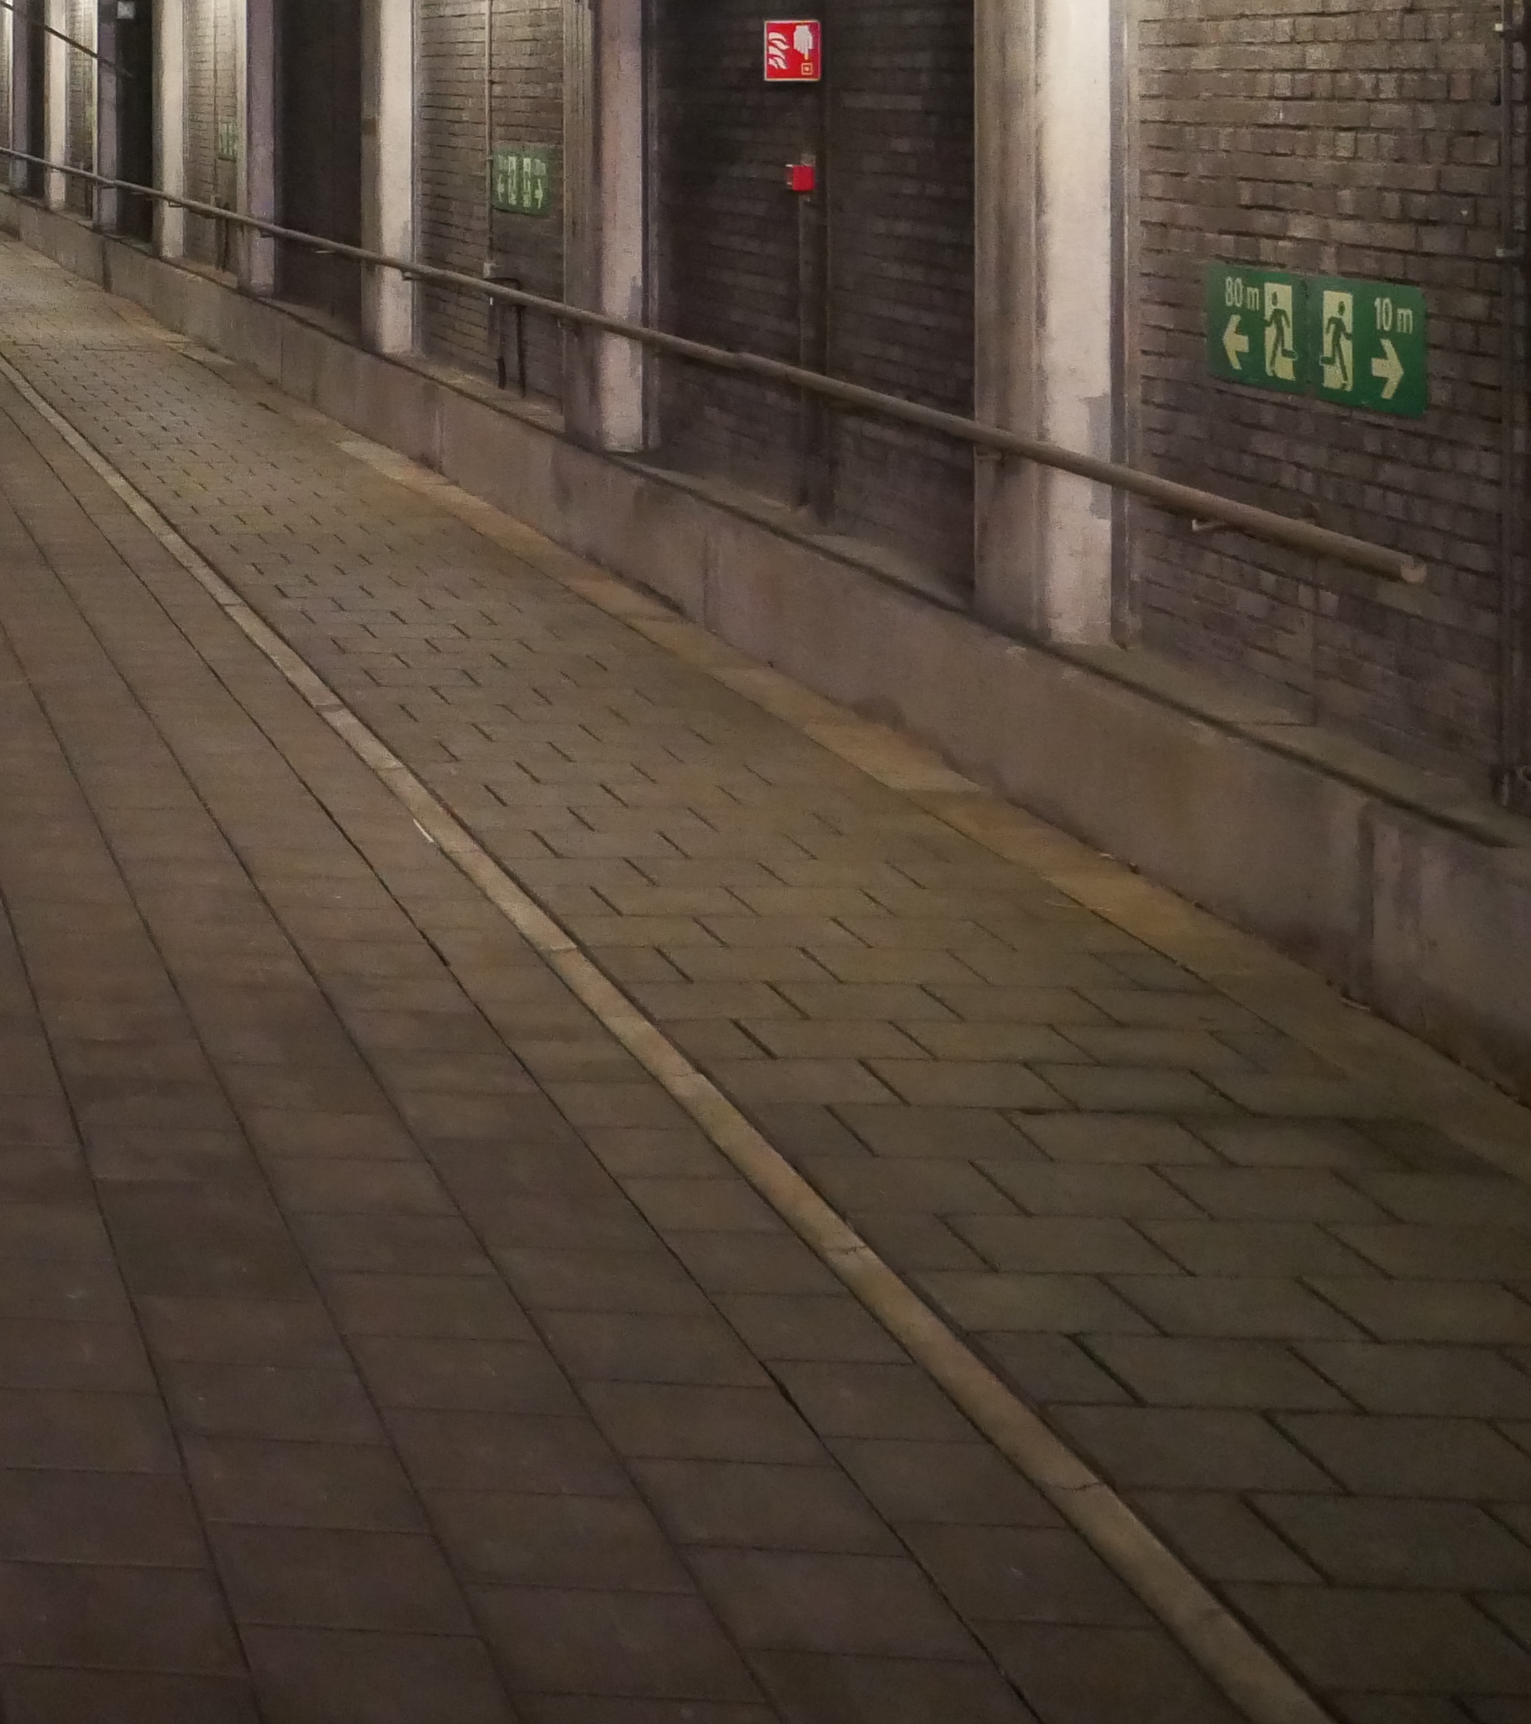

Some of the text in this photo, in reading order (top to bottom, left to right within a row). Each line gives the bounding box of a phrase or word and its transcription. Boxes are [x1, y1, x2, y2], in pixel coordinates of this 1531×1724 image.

[1225, 276, 1260, 311] 80 m
[1374, 297, 1414, 334] 10 m
